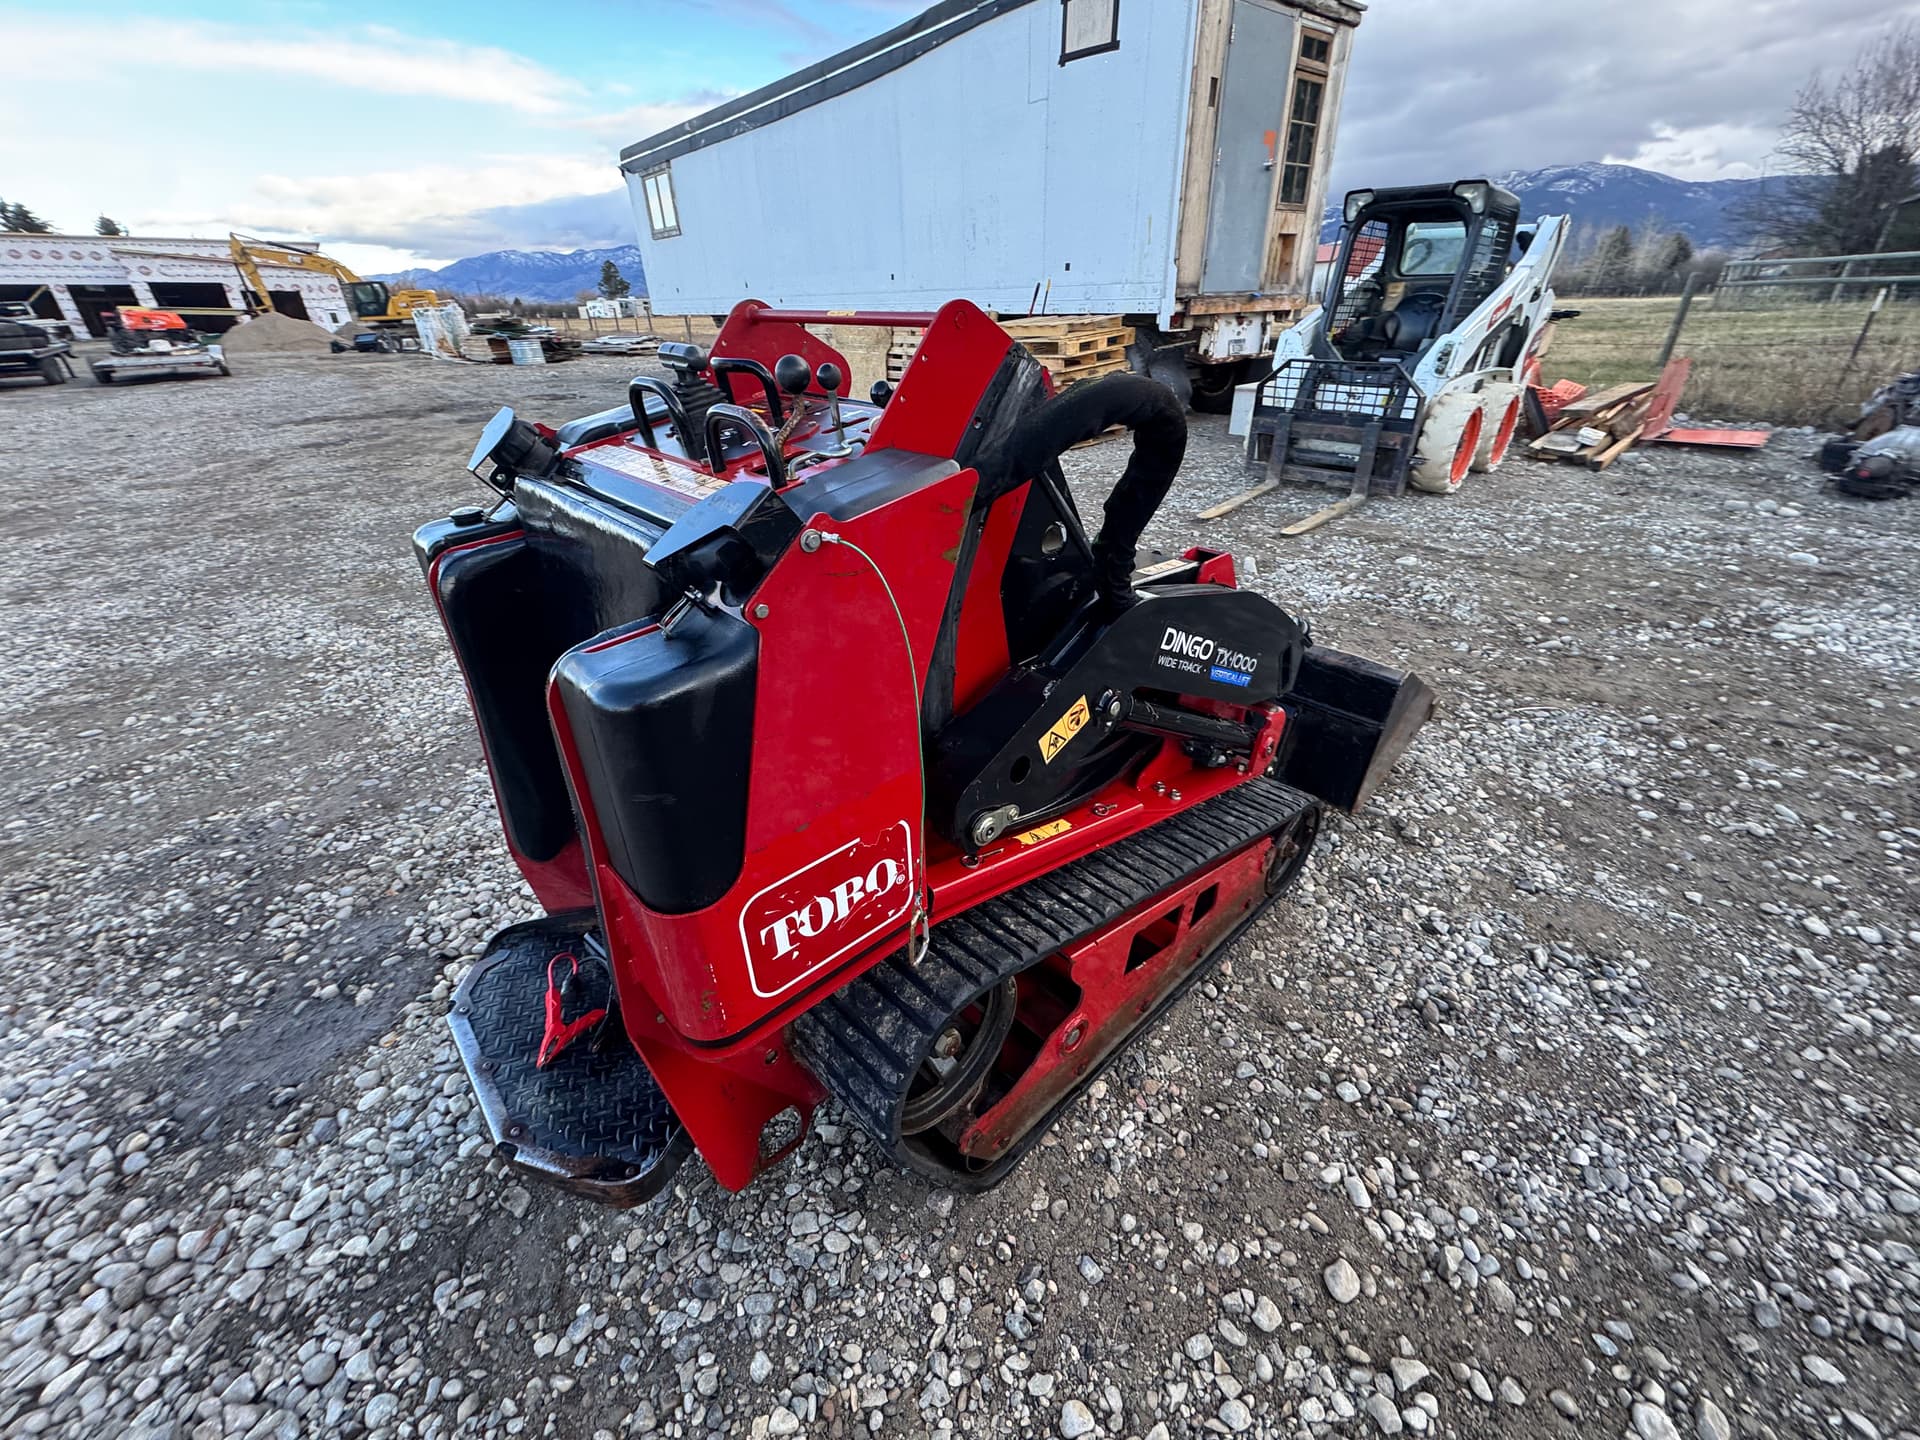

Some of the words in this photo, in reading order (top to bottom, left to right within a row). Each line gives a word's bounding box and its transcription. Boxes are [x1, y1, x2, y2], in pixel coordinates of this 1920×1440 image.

[1160, 627, 1214, 660] DINGO
[1158, 655, 1178, 669] WIDE
[1178, 660, 1203, 674] TRACK
[759, 858, 898, 961] TORO
